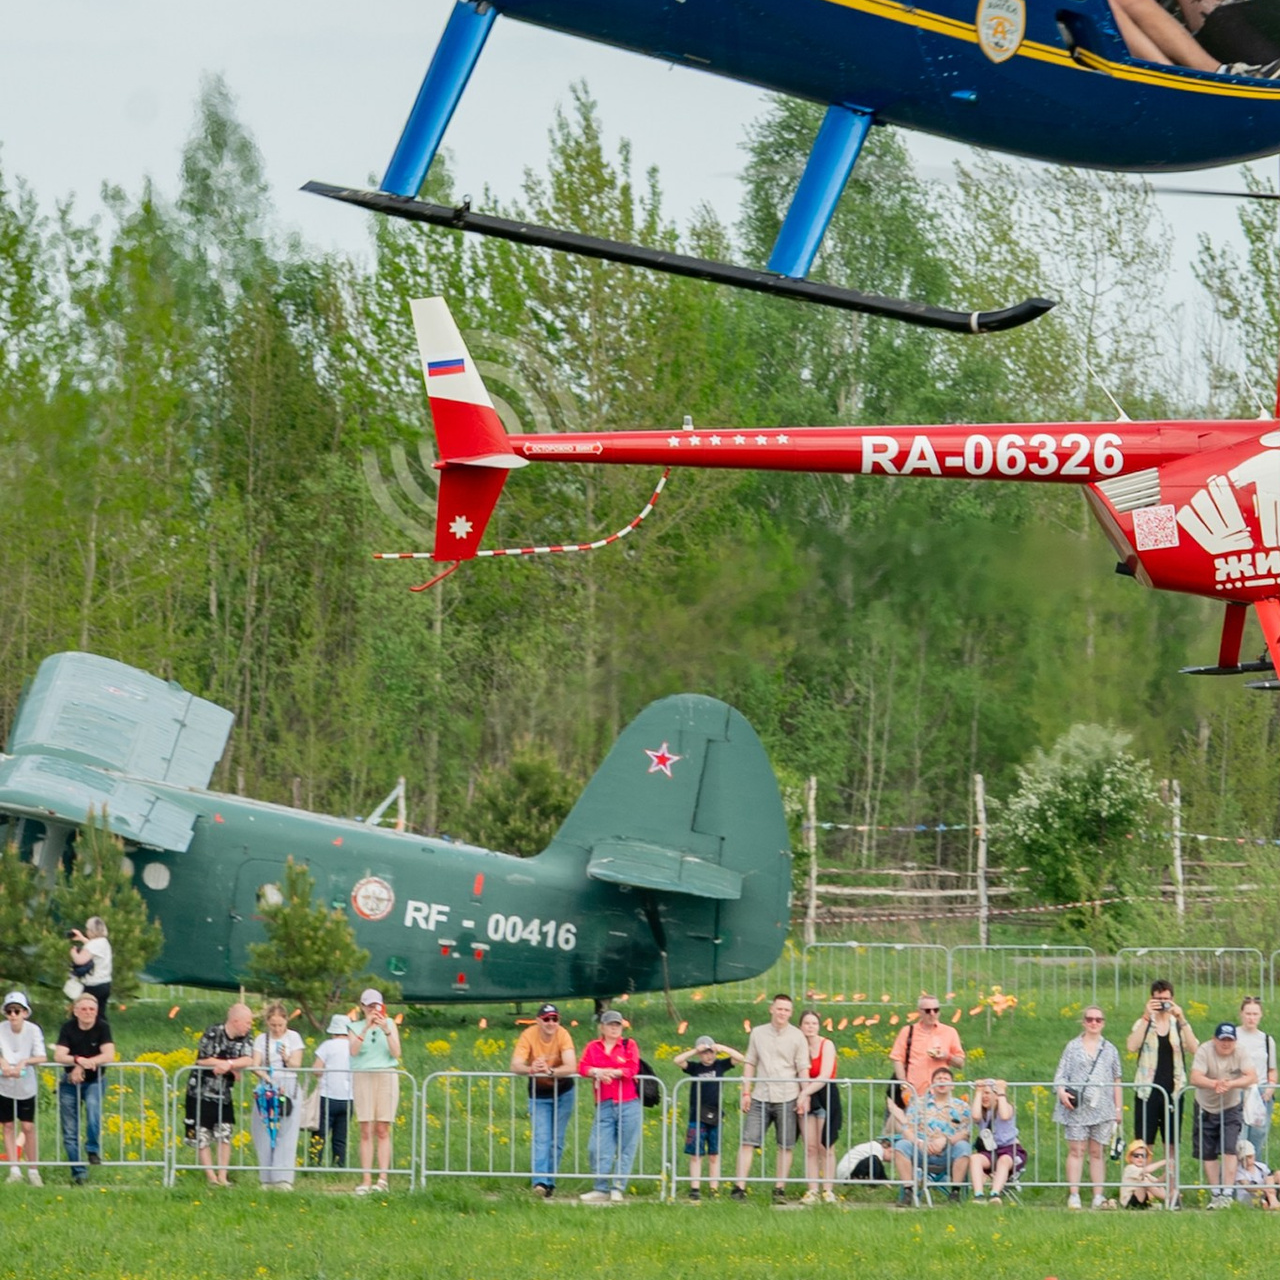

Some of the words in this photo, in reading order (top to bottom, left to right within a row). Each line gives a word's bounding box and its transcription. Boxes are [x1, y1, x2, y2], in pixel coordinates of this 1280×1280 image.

[861, 433, 1124, 476] RA-06326
[404, 900, 450, 931] RF
[487, 914, 576, 950] 00416
